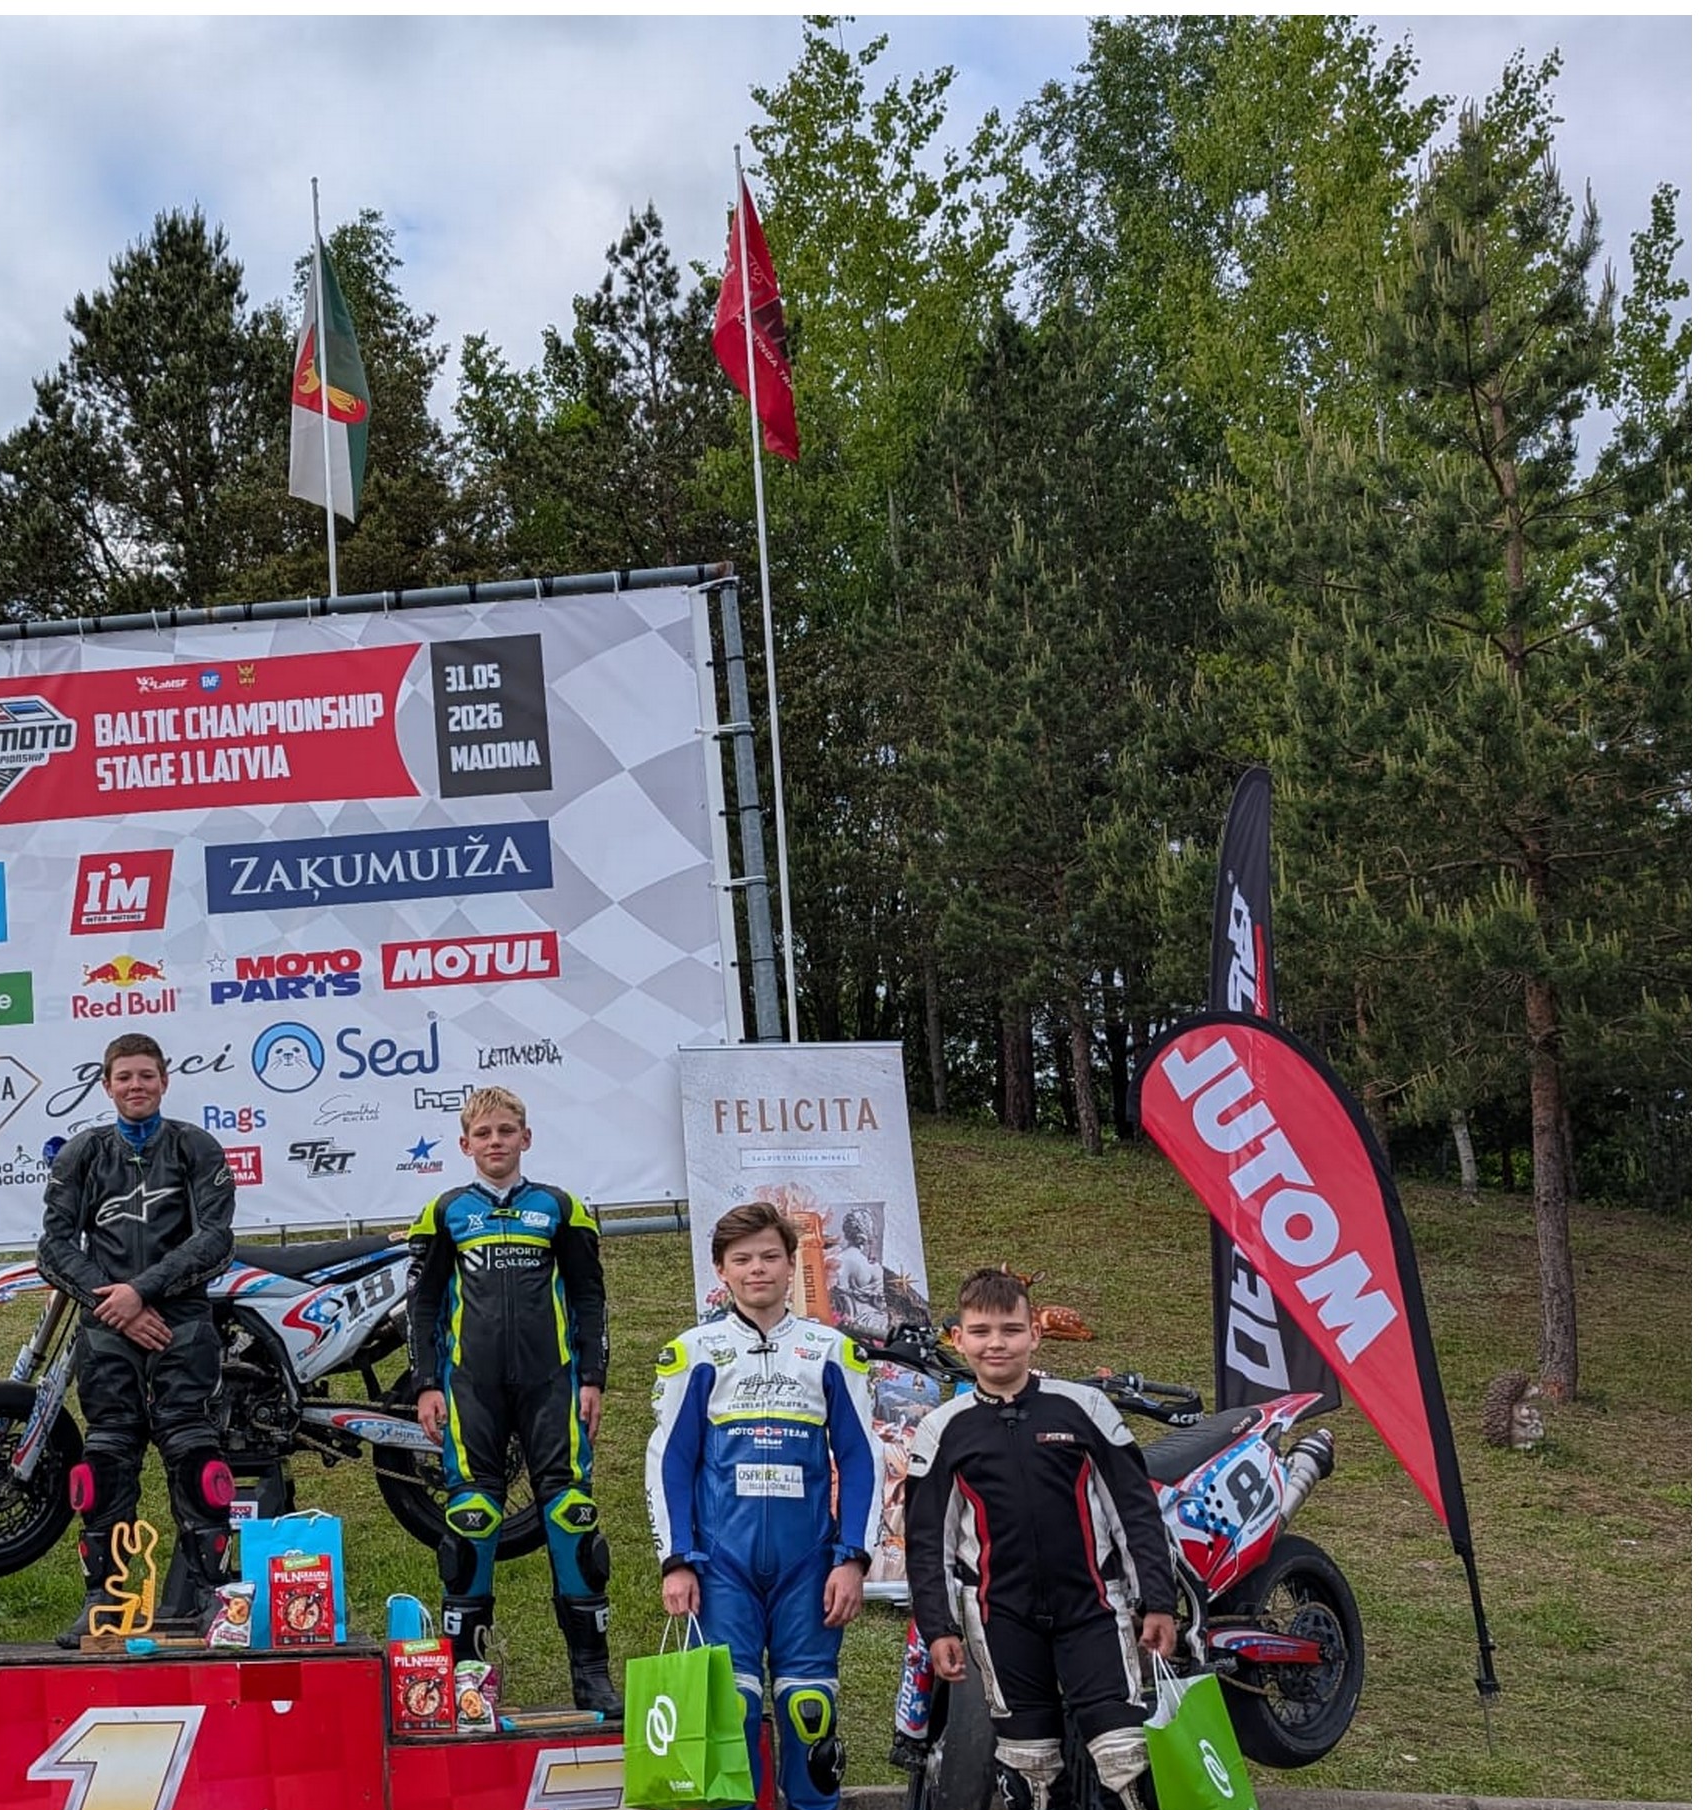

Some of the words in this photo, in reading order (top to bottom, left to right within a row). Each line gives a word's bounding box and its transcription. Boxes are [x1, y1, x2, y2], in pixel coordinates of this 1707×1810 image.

[444, 663, 502, 693] 31.05
[94, 707, 181, 748] BALTIC
[187, 692, 385, 740] CHAMPIONSHIP
[447, 703, 504, 733] 2026
[96, 751, 176, 792] STAGE
[181, 750, 195, 785] 1
[196, 744, 291, 785] LATVIA
[450, 739, 542, 773] MADONA
[229, 834, 532, 902] ZAĶUMUIŽA
[236, 948, 362, 980] MOTO
[391, 939, 552, 983] MOTUL
[72, 994, 123, 1019] Red
[127, 989, 177, 1016] Bull
[210, 972, 362, 1006] PARTS
[336, 1020, 440, 1080] Seal
[203, 1105, 267, 1134] Rags
[714, 1097, 880, 1135] FELICITA
[1225, 1459, 1275, 1521] 8
